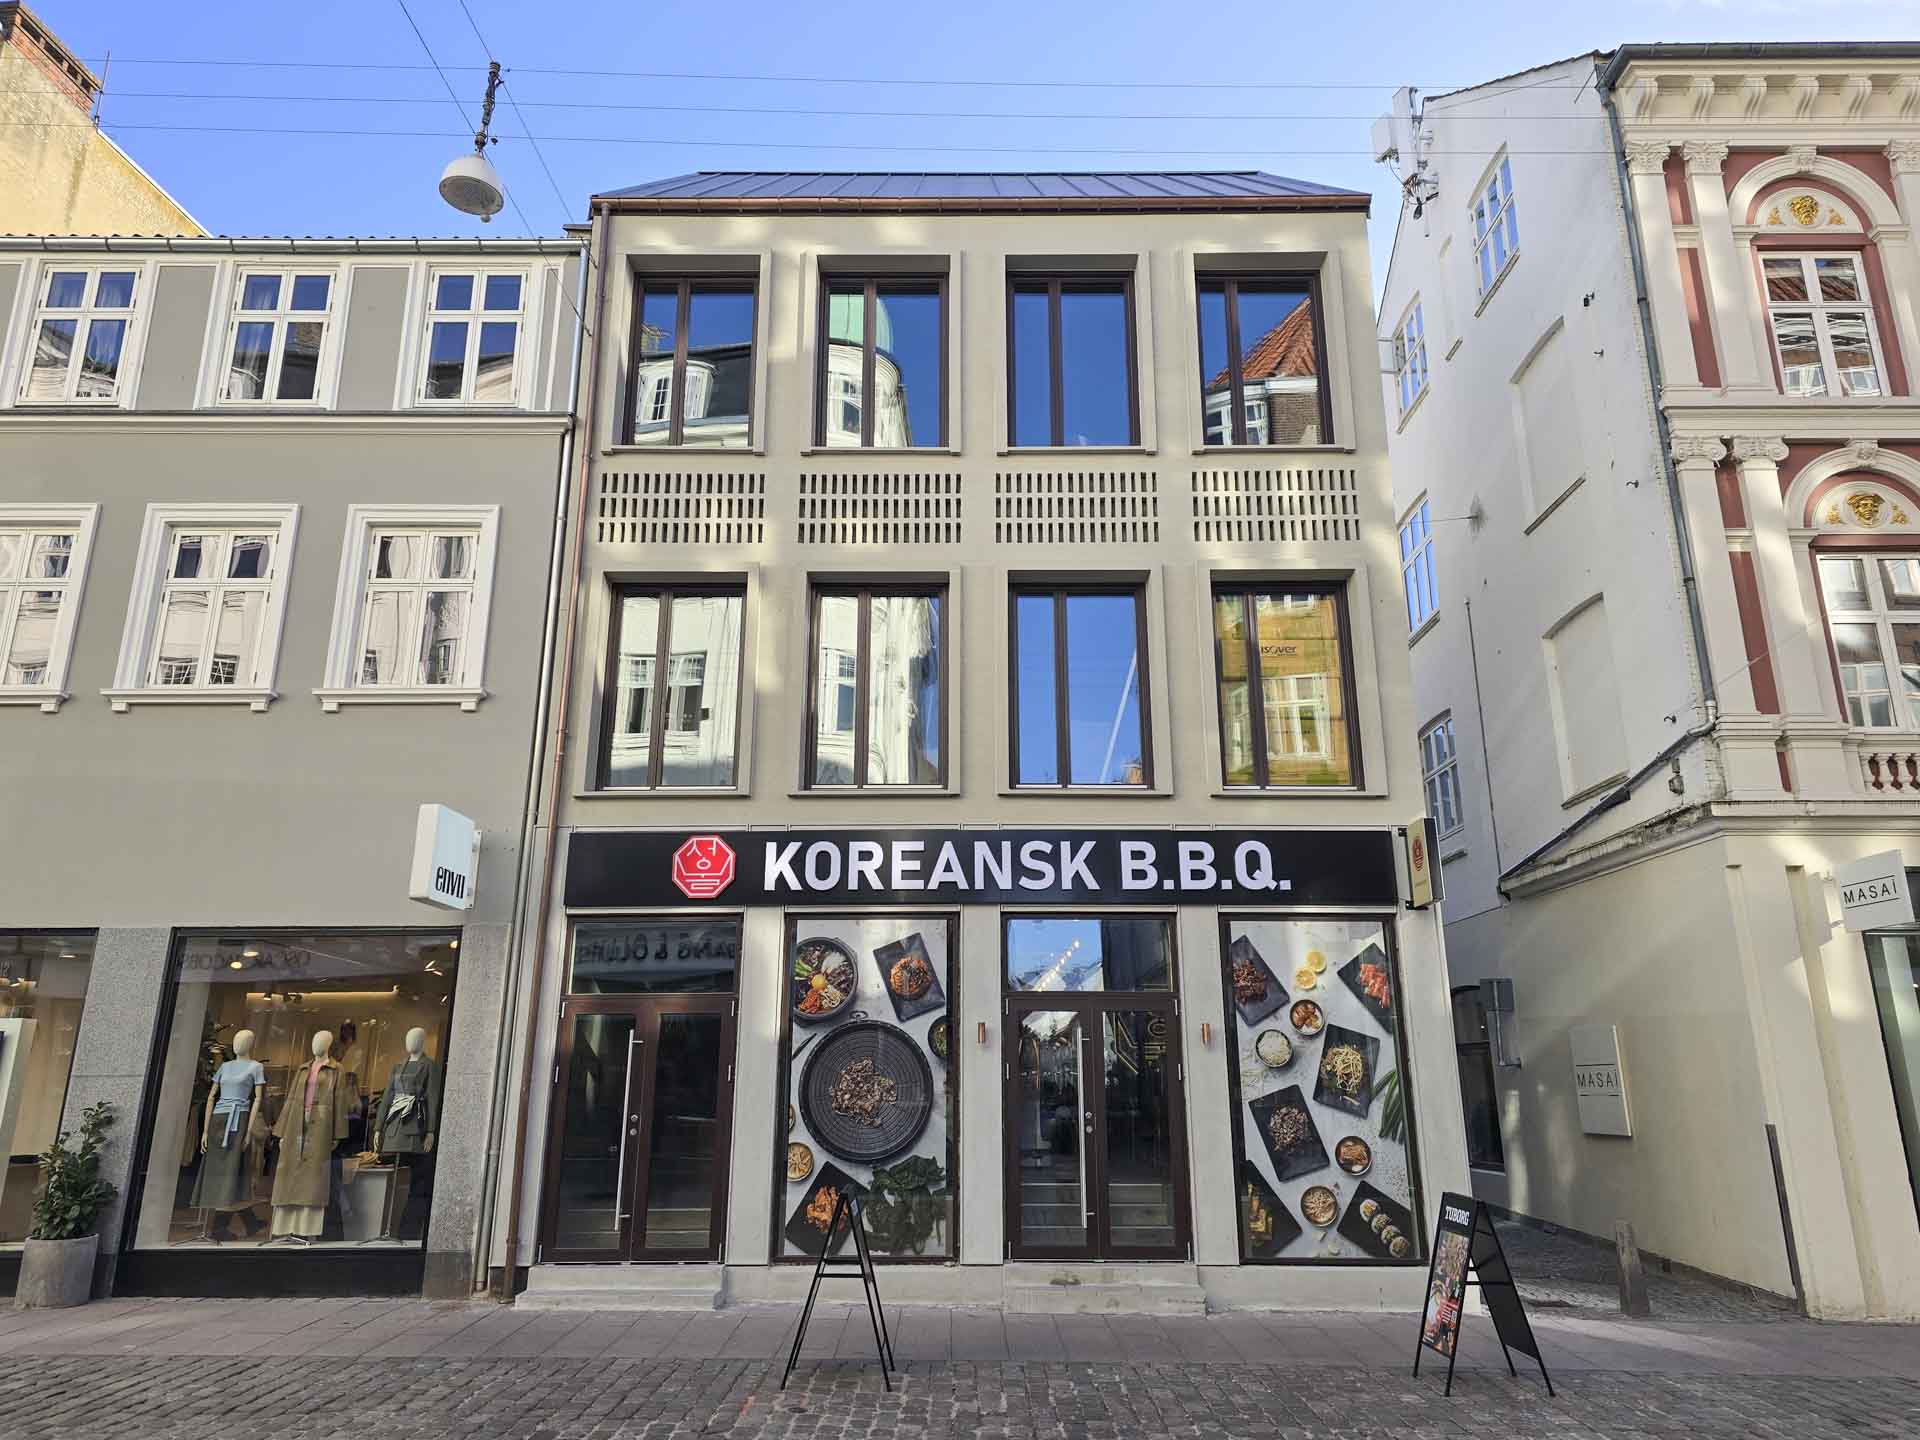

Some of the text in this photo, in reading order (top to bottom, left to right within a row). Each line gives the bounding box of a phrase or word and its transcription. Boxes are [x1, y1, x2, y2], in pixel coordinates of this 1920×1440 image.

[435, 866, 466, 899] envii
[763, 840, 1293, 892] KOREANSK B.B.Q.
[1445, 1206, 1470, 1226] TUBORG
